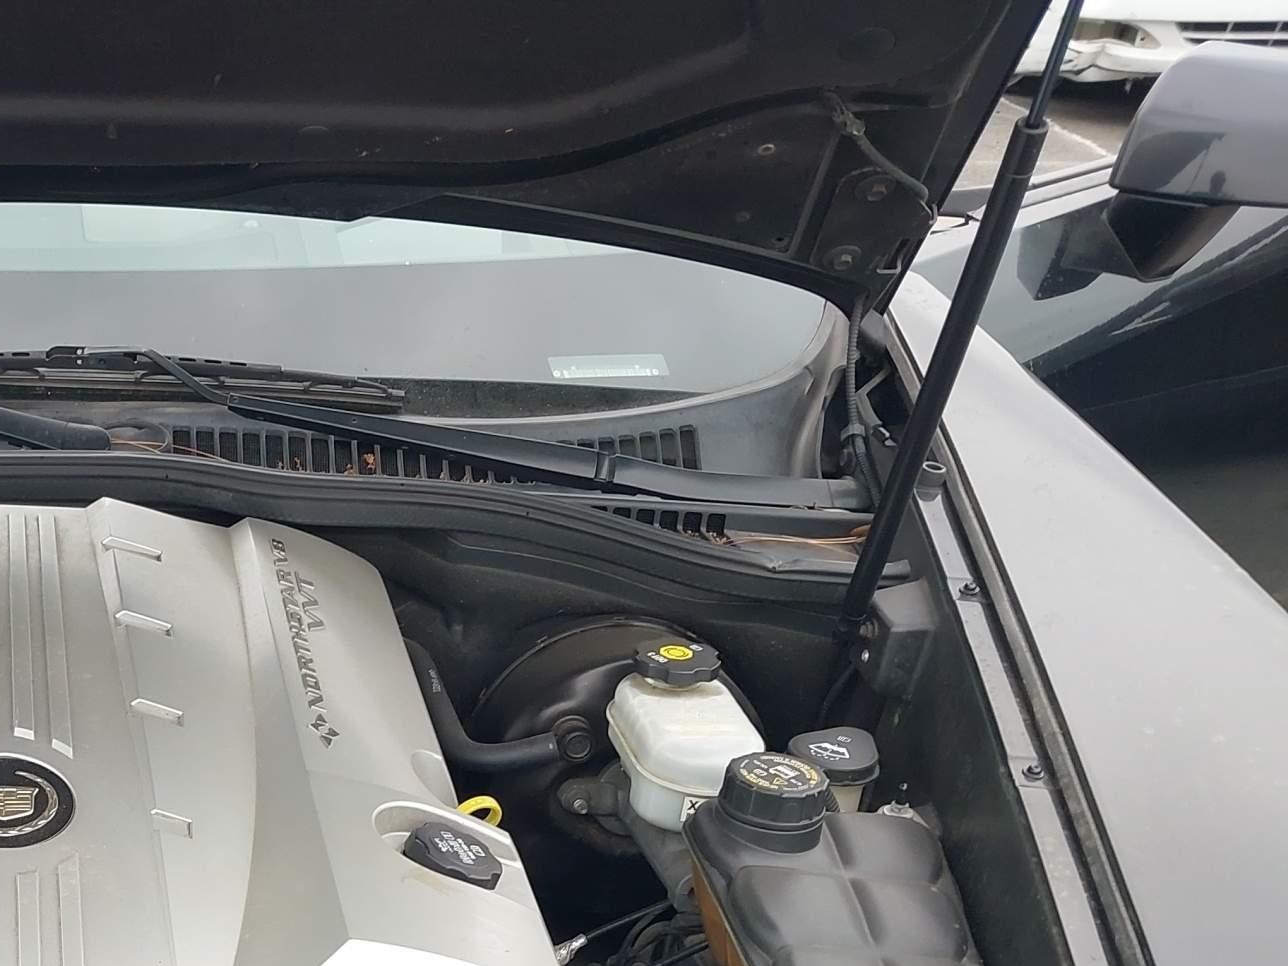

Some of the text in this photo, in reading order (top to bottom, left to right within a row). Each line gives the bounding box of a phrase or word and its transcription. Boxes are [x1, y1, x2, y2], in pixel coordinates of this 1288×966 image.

[271, 538, 328, 713] NORTHSTAR V8
[295, 570, 326, 633] VVT
